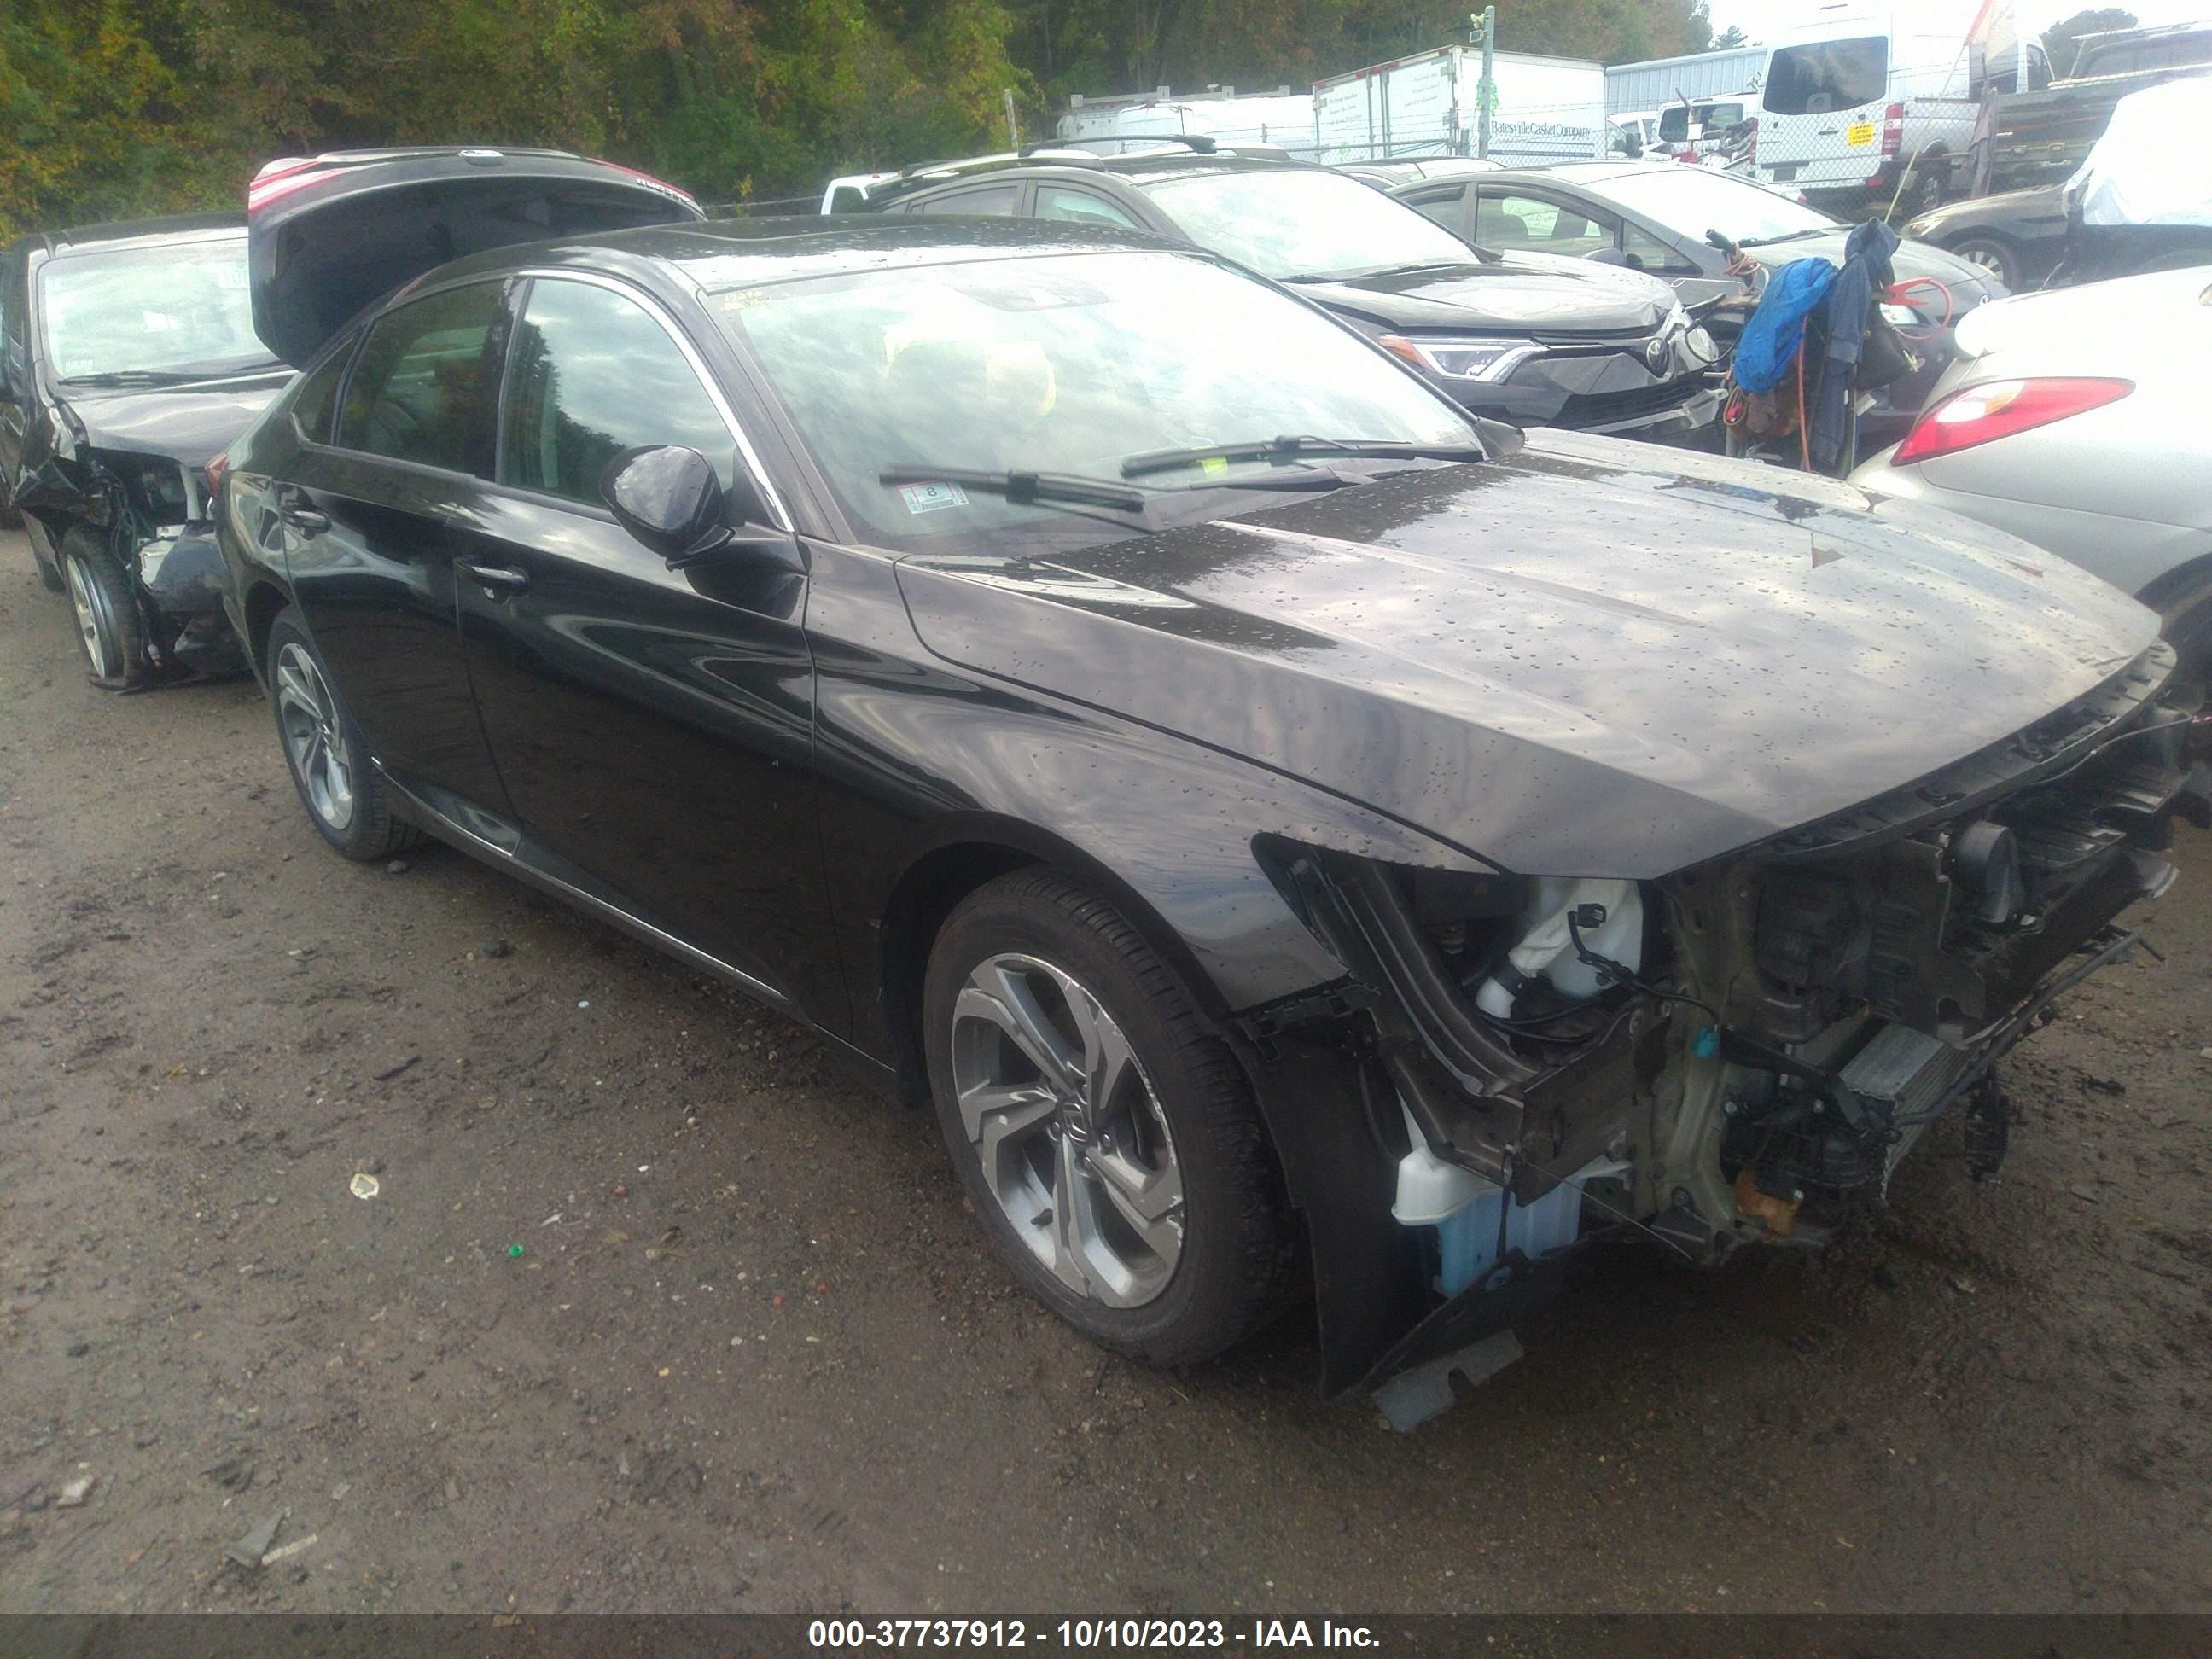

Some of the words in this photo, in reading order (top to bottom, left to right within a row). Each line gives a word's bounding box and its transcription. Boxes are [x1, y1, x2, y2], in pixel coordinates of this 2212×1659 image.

[1491, 121, 1529, 135] Batesville
[1530, 122, 1556, 137] Casket
[1556, 123, 1591, 138] Company
[926, 486, 937, 497] 8
